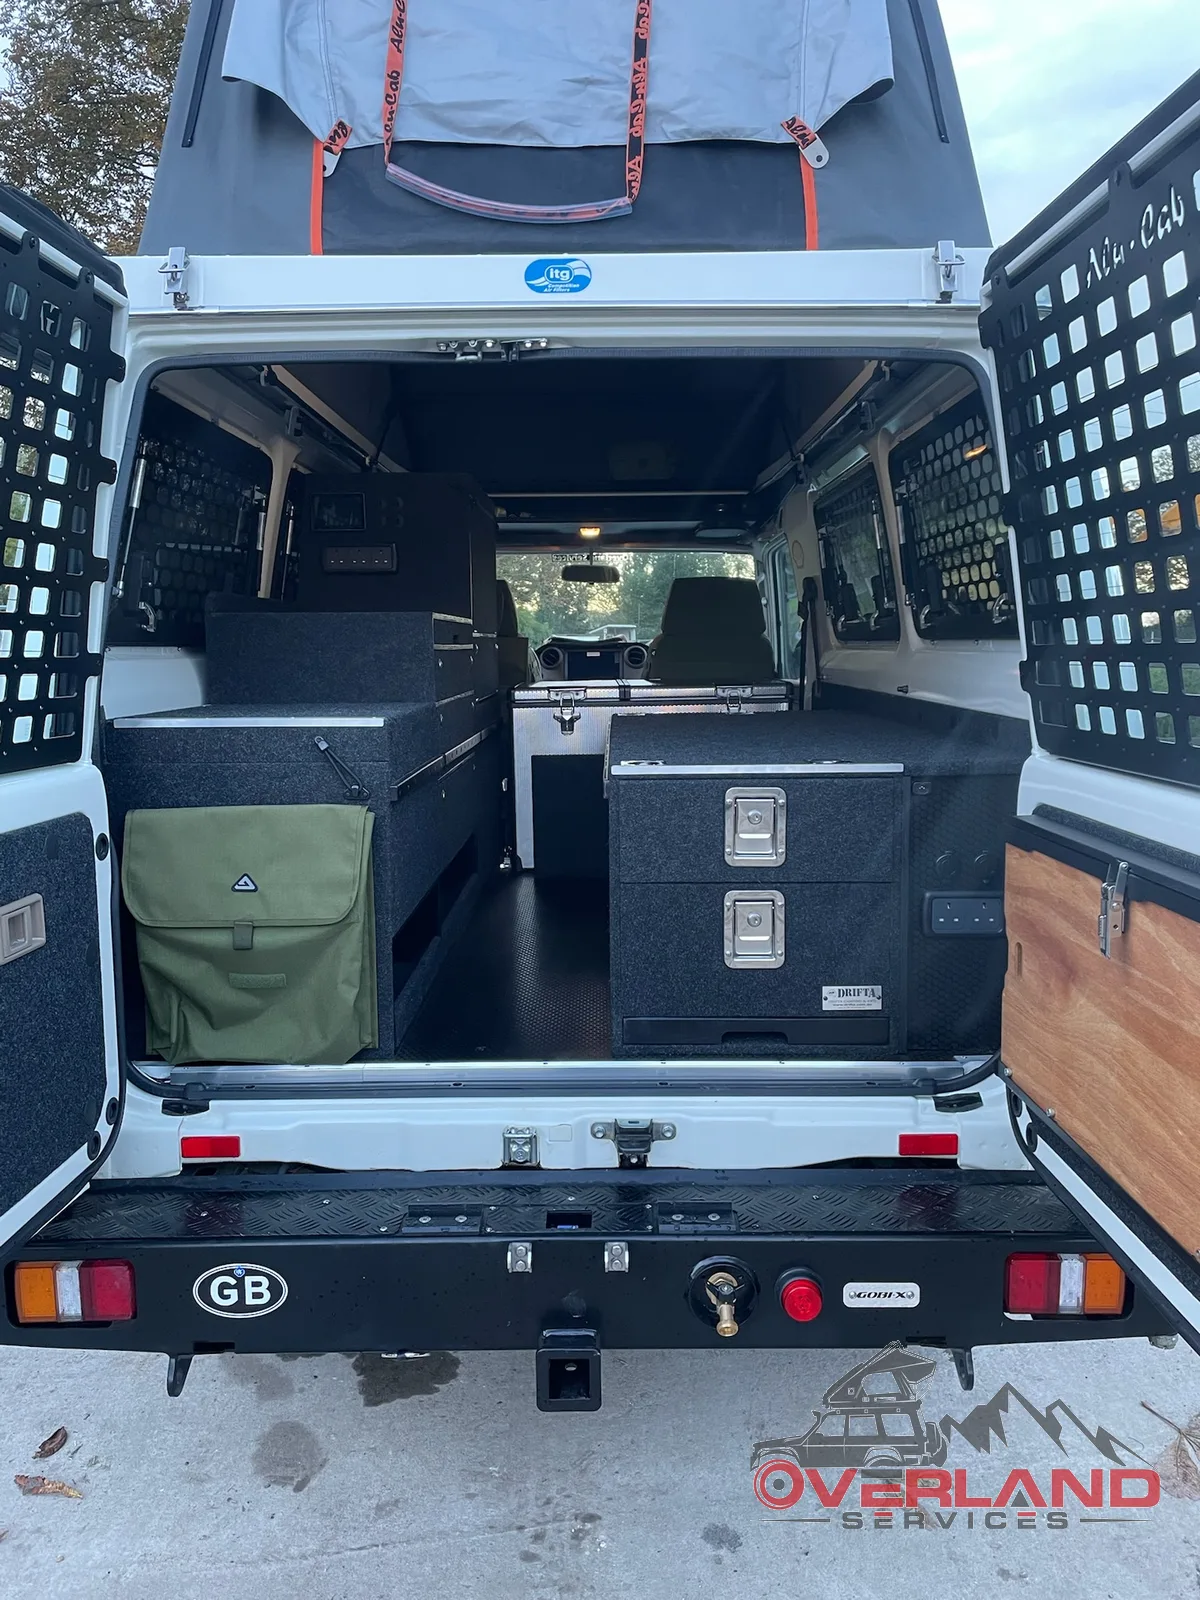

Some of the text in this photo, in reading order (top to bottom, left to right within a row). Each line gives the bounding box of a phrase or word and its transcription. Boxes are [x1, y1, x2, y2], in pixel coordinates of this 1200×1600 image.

[549, 268, 570, 281] itg
[838, 988, 876, 998] DRIFTA
[210, 1275, 271, 1307] GB
